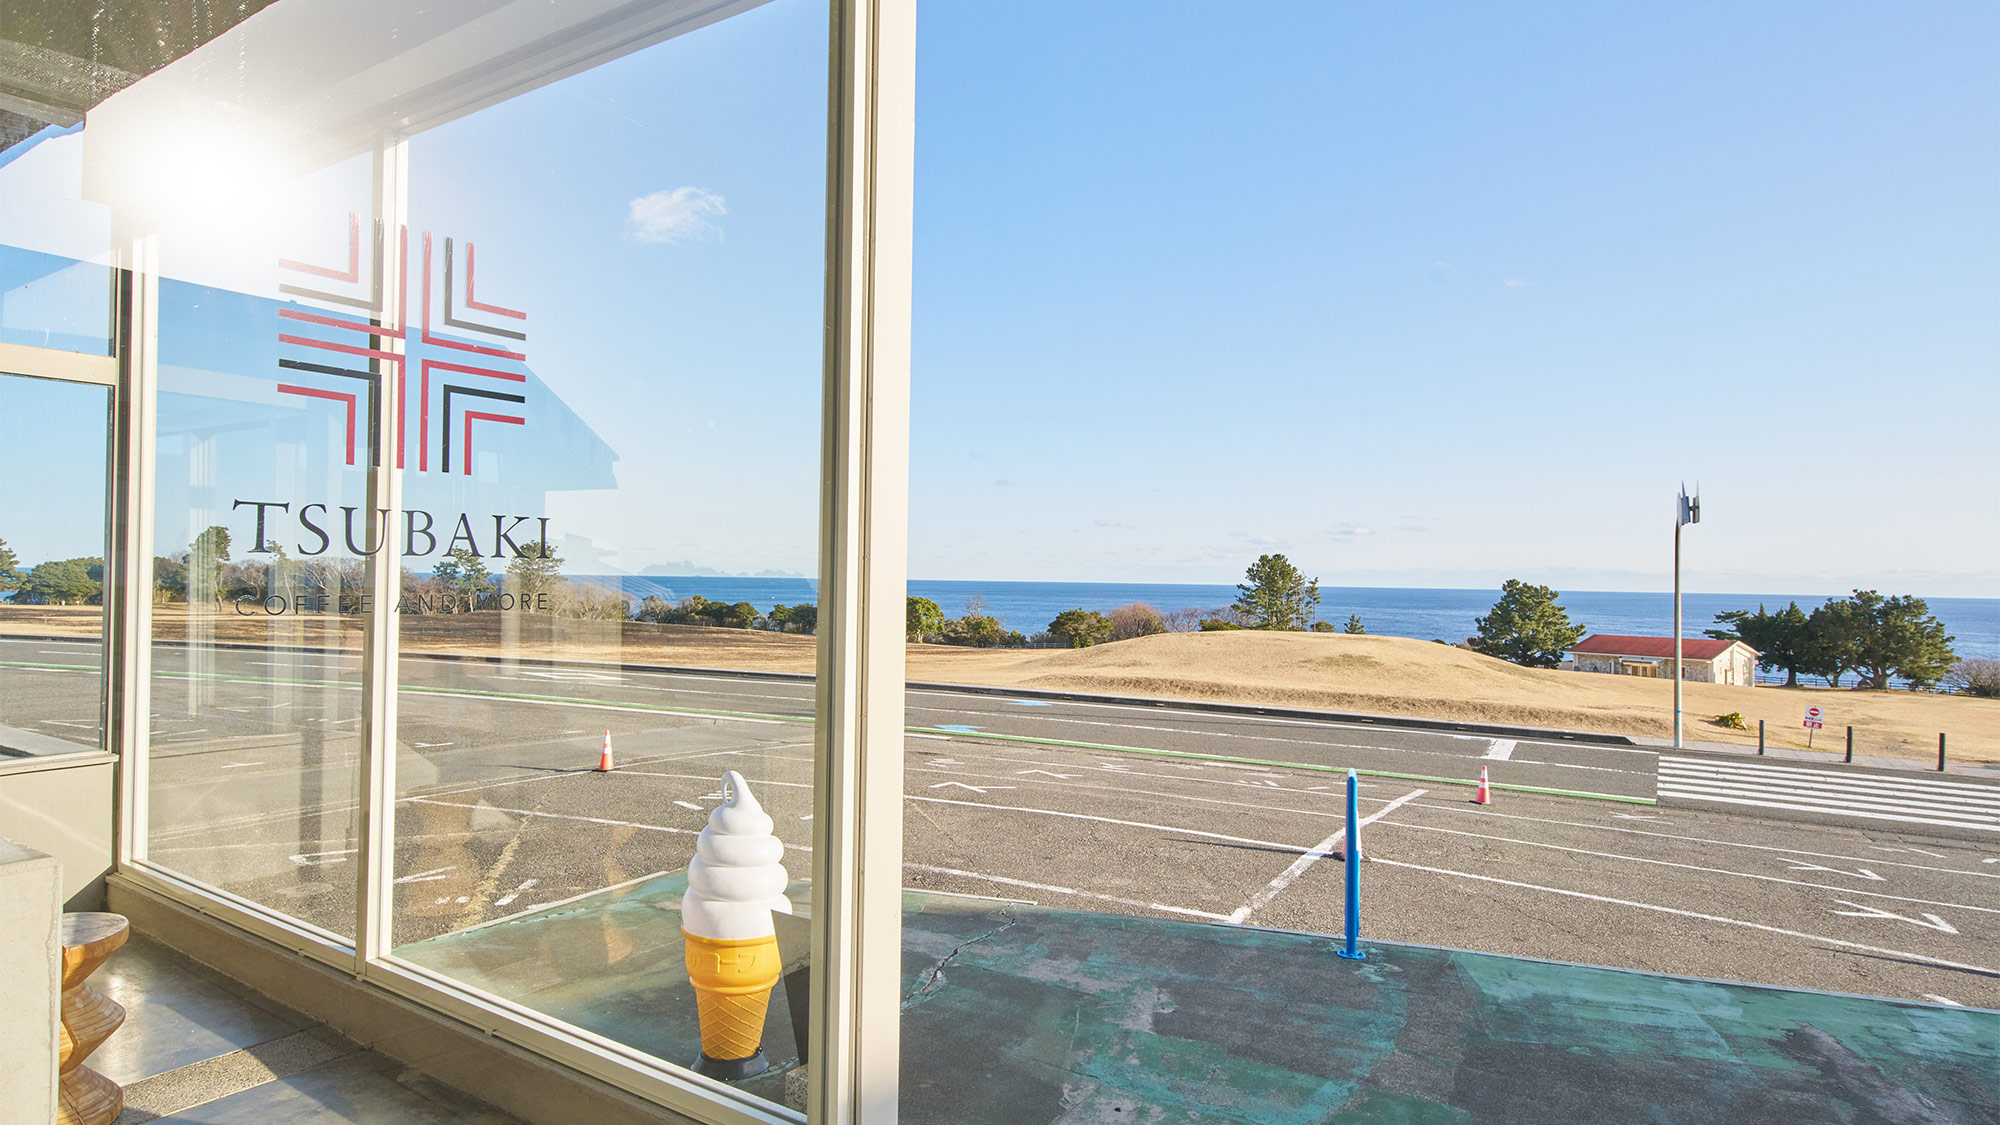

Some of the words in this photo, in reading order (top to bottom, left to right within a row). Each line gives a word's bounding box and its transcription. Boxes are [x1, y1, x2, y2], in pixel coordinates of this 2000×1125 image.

[233, 499, 551, 559] TSUBAKI
[235, 594, 374, 617] COFFEE
[394, 592, 459, 613] AND
[478, 593, 549, 612] MORE
